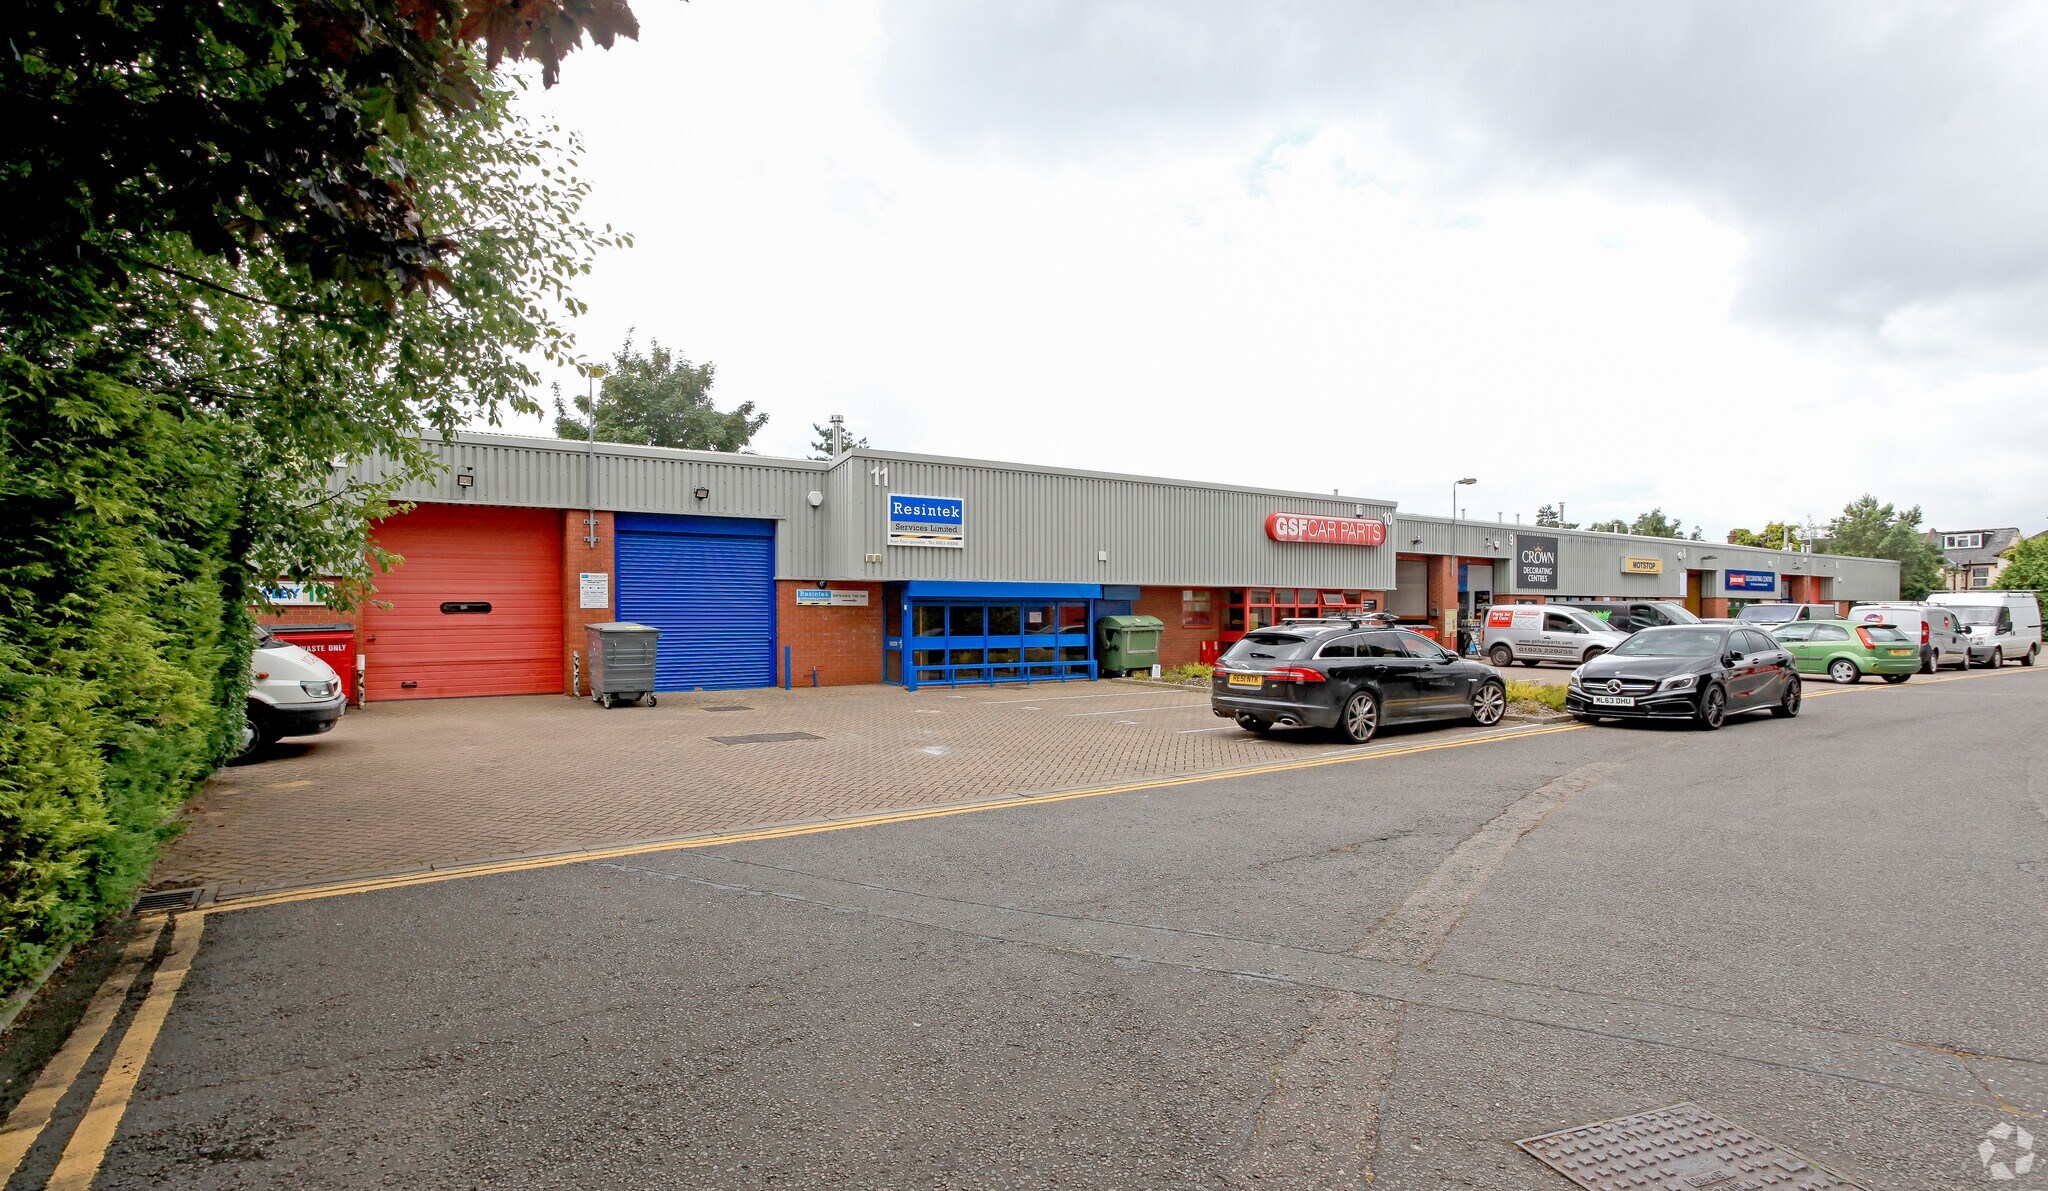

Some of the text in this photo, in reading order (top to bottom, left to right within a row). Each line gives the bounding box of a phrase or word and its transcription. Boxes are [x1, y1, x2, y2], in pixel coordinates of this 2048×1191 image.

[870, 466, 889, 487] 11
[893, 502, 960, 518] Resintek
[1382, 511, 1393, 526] 10
[895, 523, 958, 533] Services Limited
[1340, 522, 1381, 540] PARTS
[1508, 534, 1514, 546] 9
[1521, 550, 1555, 564] CROWN
[1682, 548, 1687, 559] 8
[1523, 566, 1553, 575] DECORATING
[1632, 561, 1656, 570] MOTSTOP
[1527, 574, 1548, 583] CENTRES
[800, 590, 829, 598] Resintek
[328, 644, 347, 652] ONLY
